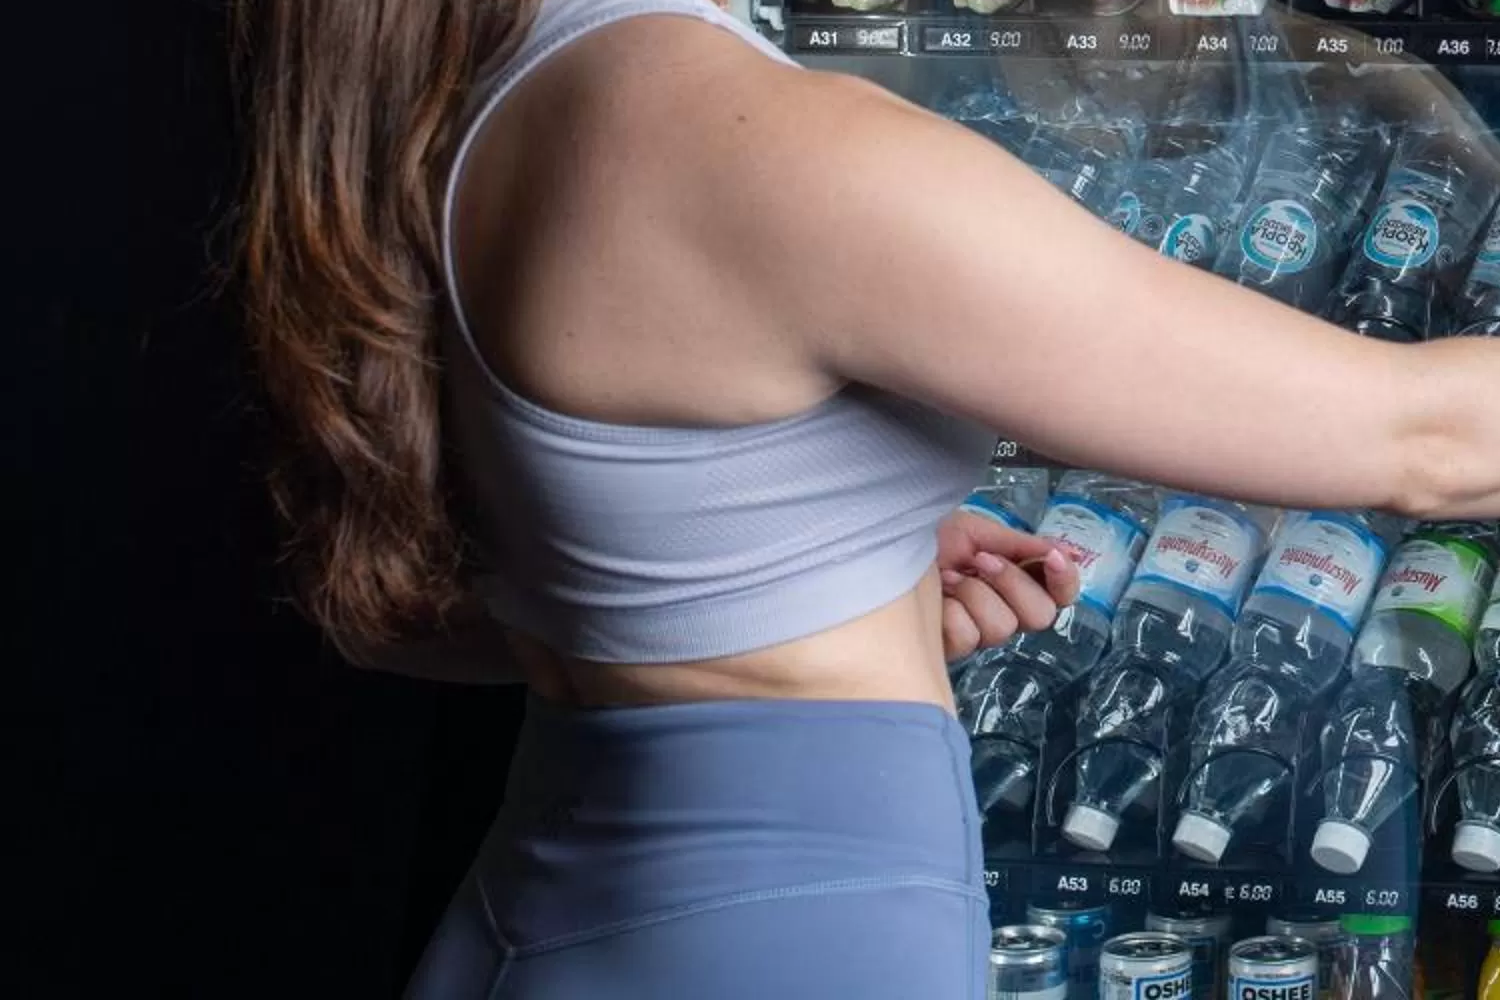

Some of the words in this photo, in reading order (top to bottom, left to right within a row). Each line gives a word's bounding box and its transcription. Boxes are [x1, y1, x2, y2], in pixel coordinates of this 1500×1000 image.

[809, 31, 838, 46] A31
[941, 33, 971, 47] A32
[1067, 35, 1097, 49] A33
[1198, 35, 1228, 51] A34
[1317, 37, 1348, 53] A35
[1437, 39, 1470, 55] A36
[1057, 876, 1088, 891] A53
[1179, 882, 1210, 896] A54
[1315, 889, 1346, 904] A55
[1447, 893, 1478, 909] A56
[1241, 983, 1310, 1000] OSHEE
